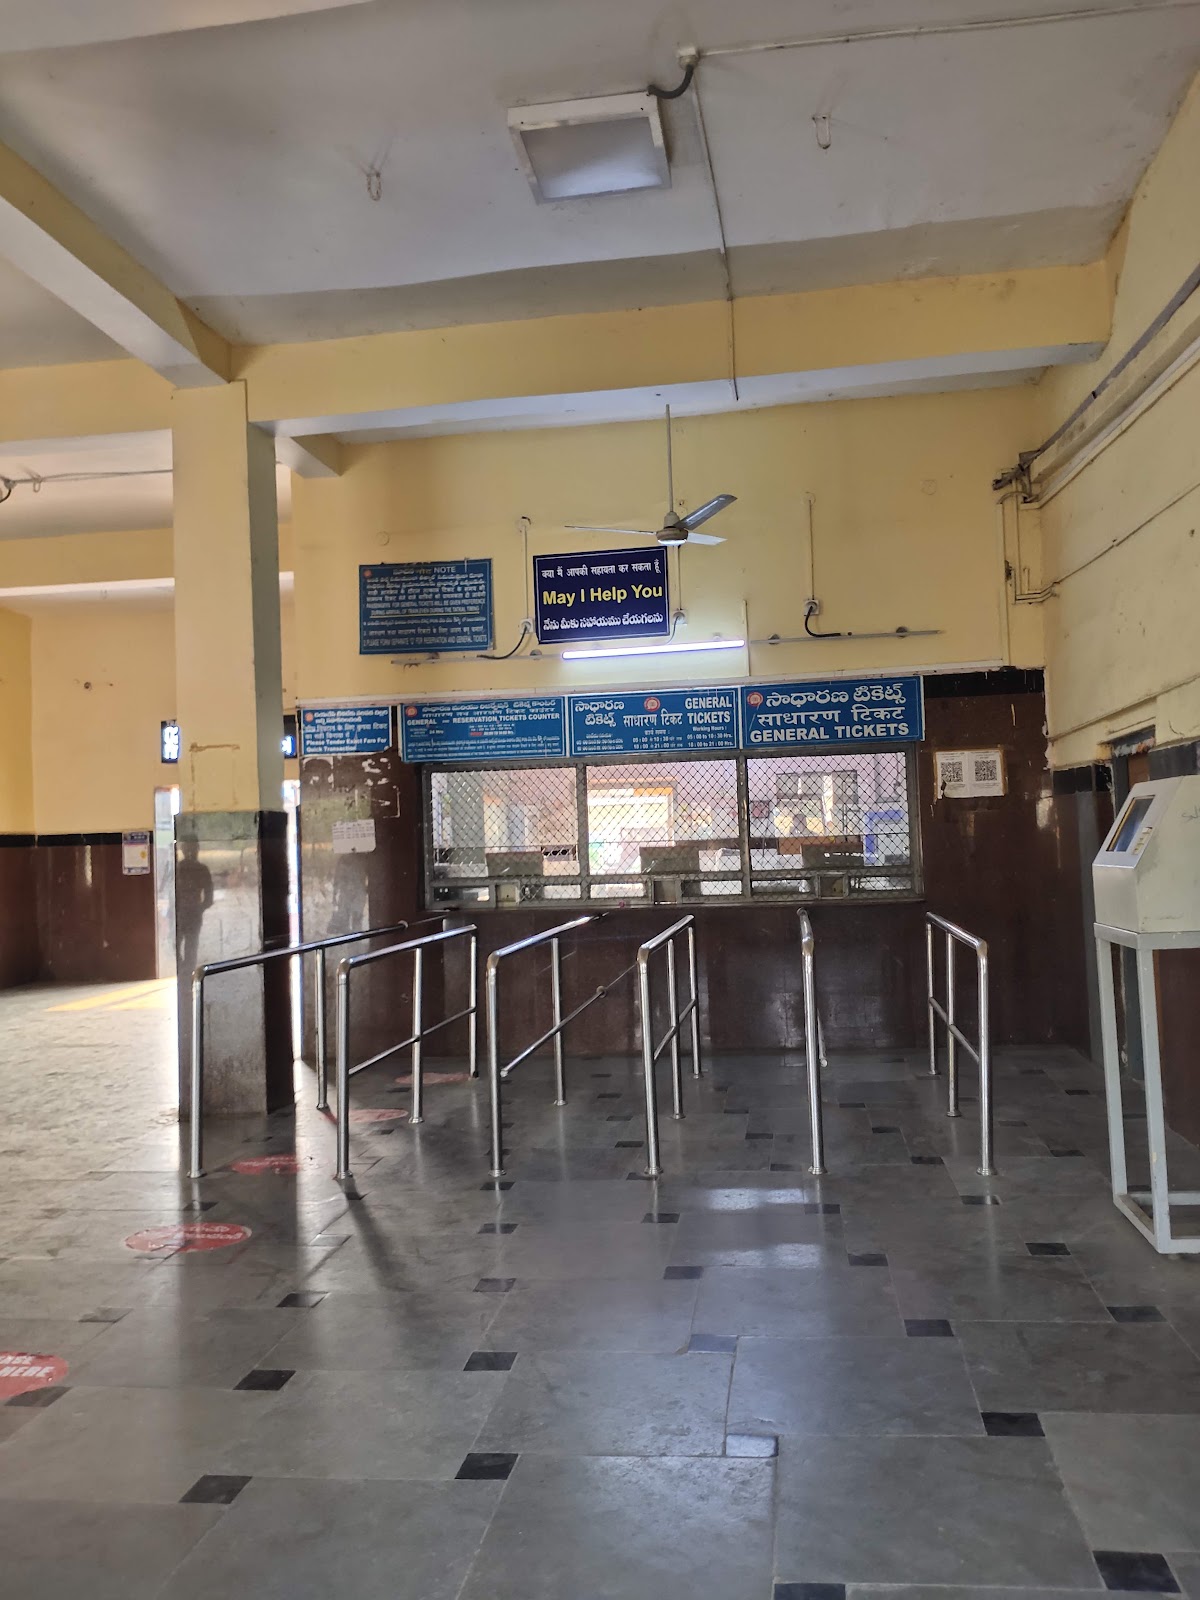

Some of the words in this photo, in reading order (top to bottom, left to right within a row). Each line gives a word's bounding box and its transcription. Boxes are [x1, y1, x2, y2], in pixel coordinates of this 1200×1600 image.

[541, 569, 554, 578] क्या
[618, 564, 628, 573] कर
[543, 591, 575, 607] May
[581, 588, 585, 602] I
[590, 586, 627, 603] Help
[631, 584, 663, 598] You
[685, 696, 732, 709] GENERAL
[766, 689, 849, 708] సాధారణ
[853, 683, 907, 704] టికెట్స్
[575, 700, 624, 713] సాధారణ
[585, 712, 616, 727] టికెట్స్
[623, 714, 657, 727] साधारण
[661, 708, 683, 726] टिकट
[687, 711, 730, 724] TICKETS
[757, 710, 841, 727] साधारण
[851, 704, 906, 722] टिकट
[750, 726, 829, 743] GENERAL
[834, 723, 909, 739] TICKETS
